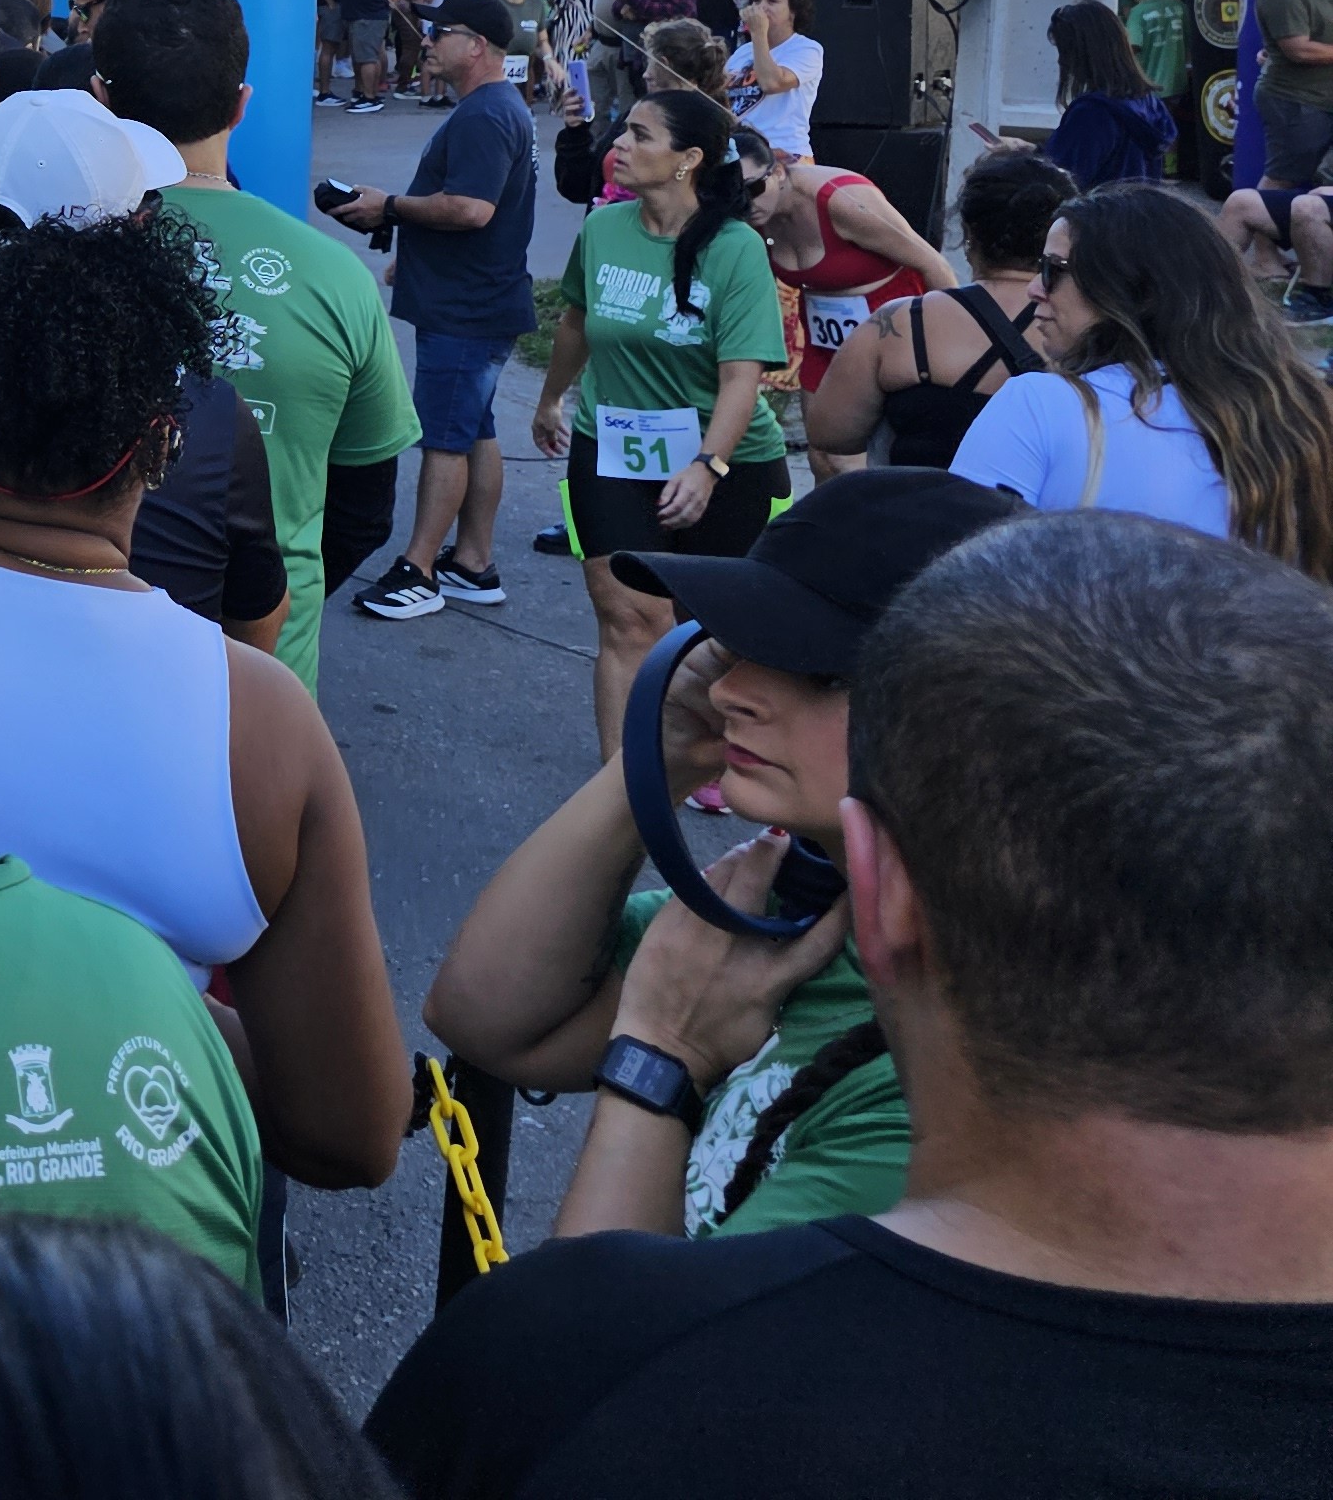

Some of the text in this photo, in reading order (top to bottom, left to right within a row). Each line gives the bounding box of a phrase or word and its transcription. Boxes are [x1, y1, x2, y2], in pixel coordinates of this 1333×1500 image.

[596, 263, 662, 299] CORRIDA
[623, 435, 670, 473] 51
[106, 1035, 191, 1095] PREFEITURA DO
[46, 1136, 103, 1156] Municipal
[115, 1117, 202, 1168] RIO GRANDE
[5, 1160, 36, 1186] RIO
[38, 1153, 107, 1183] GRANDE
